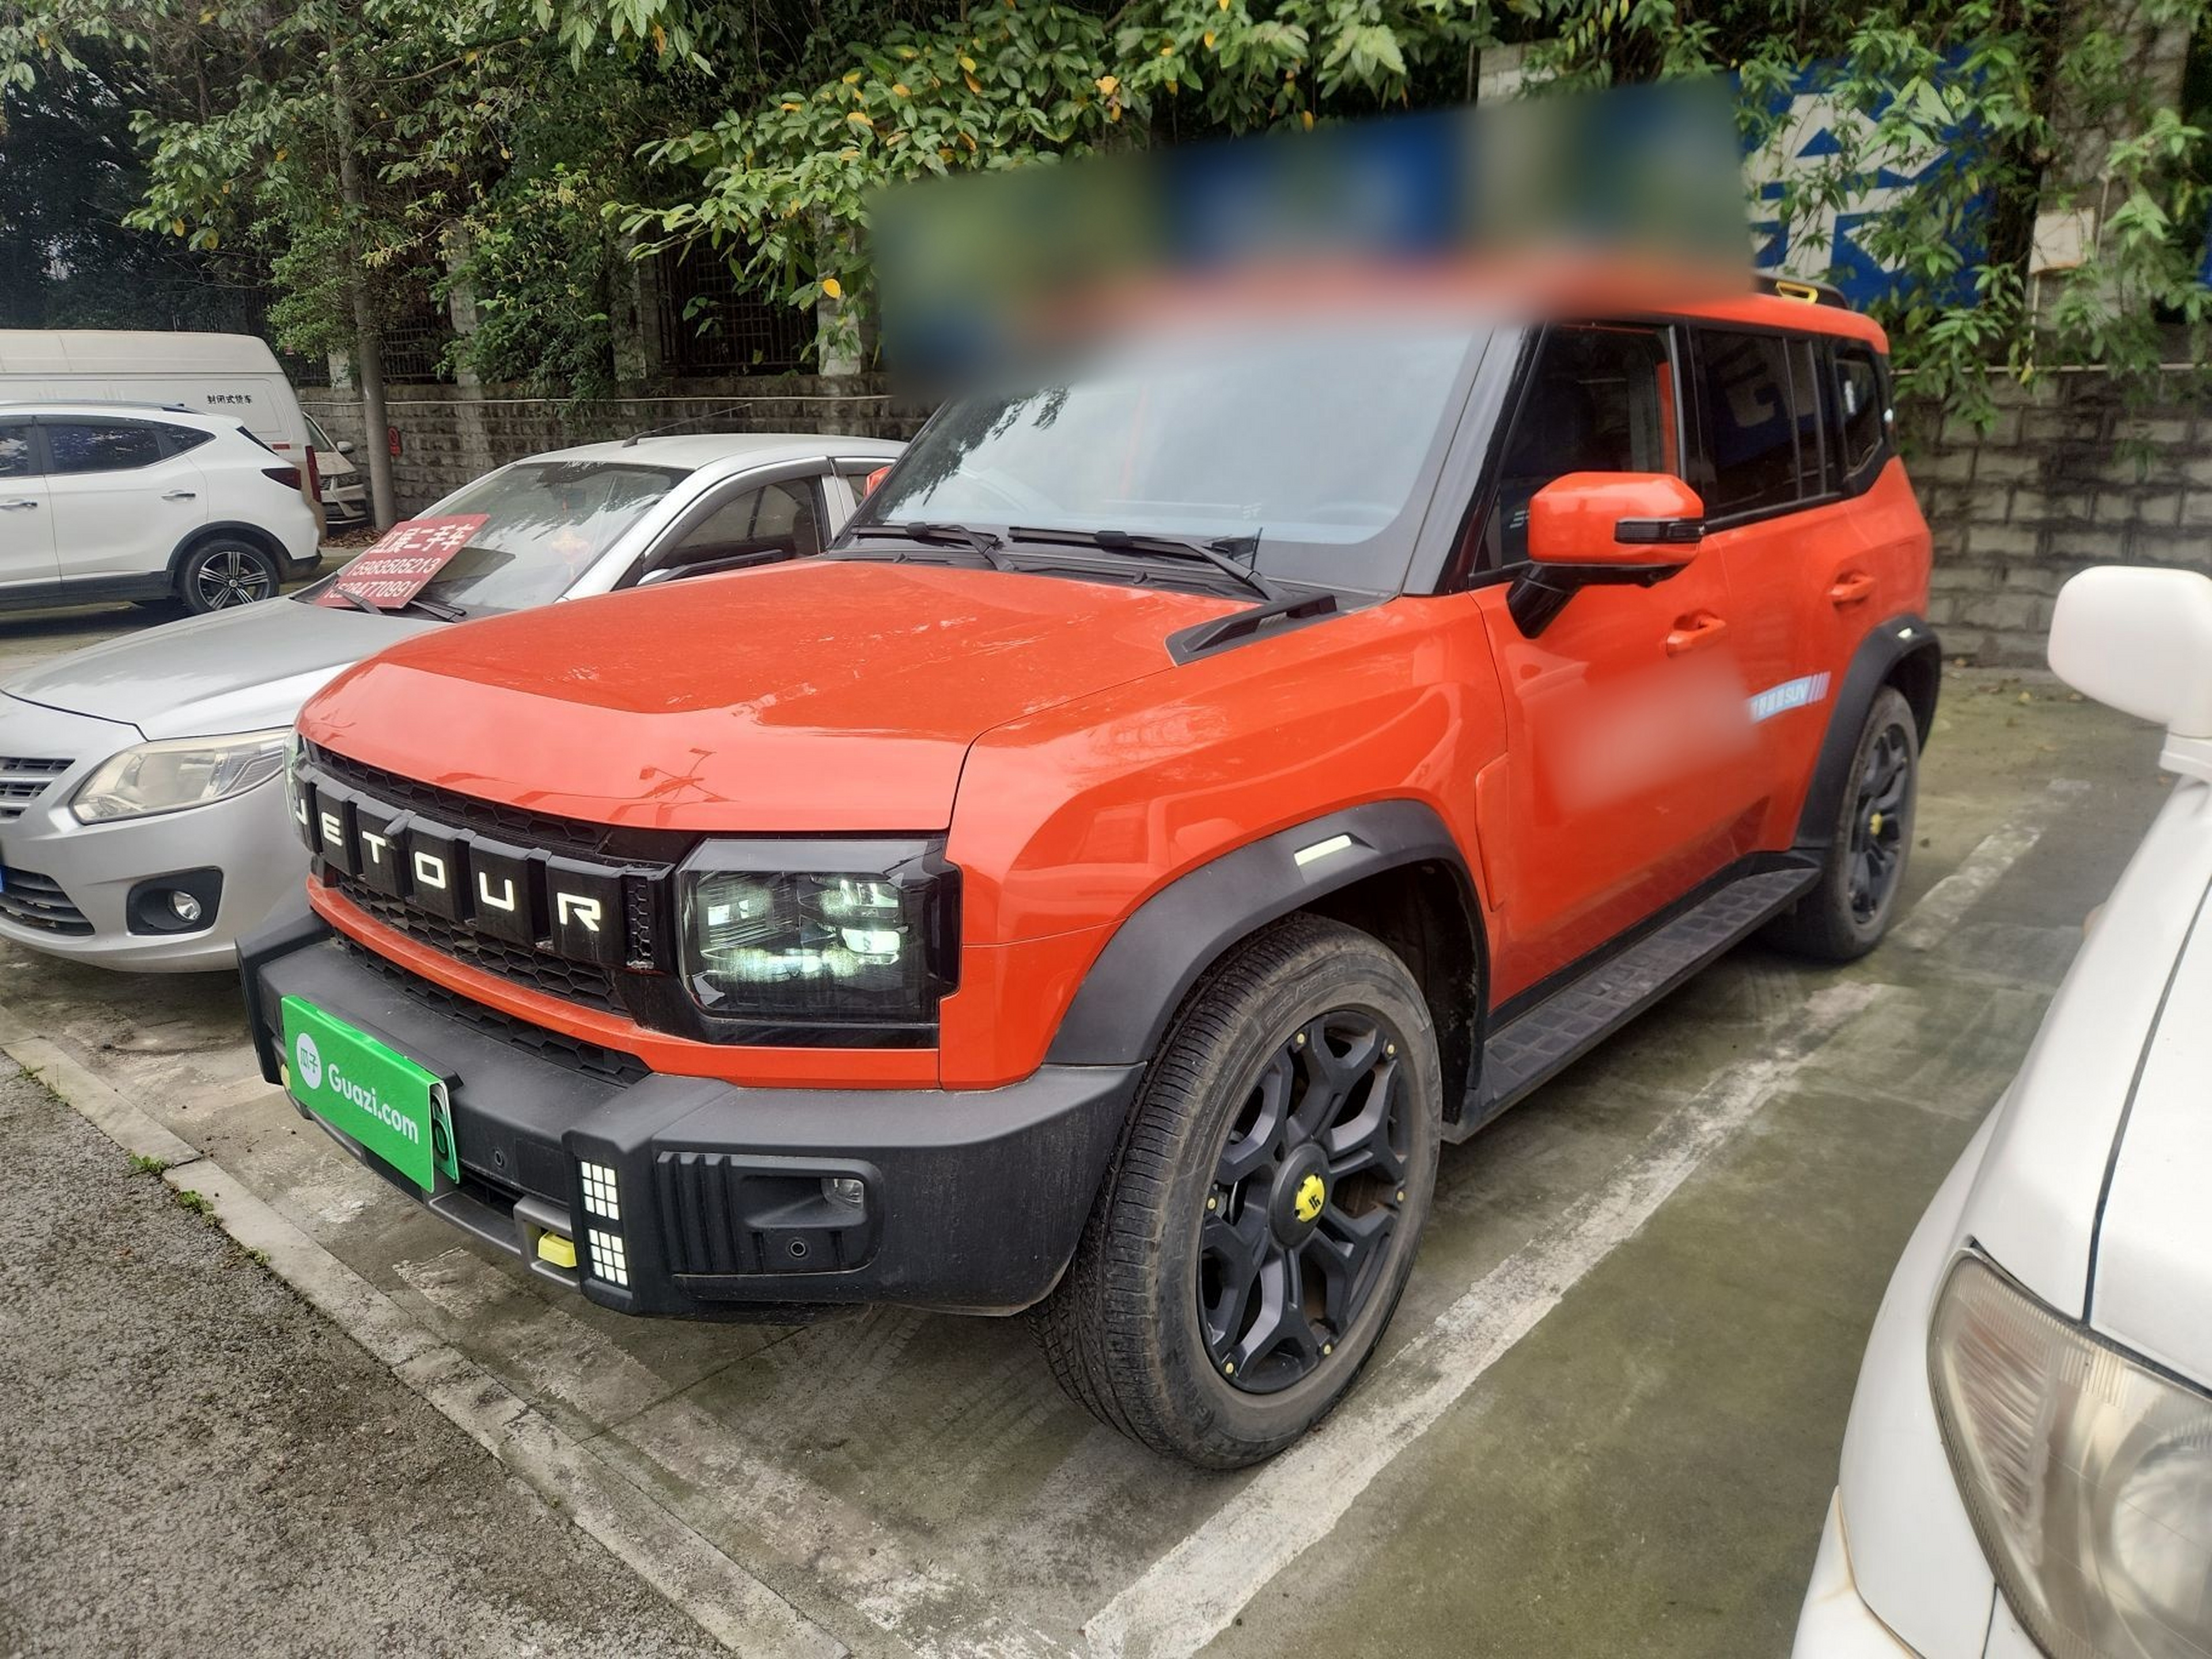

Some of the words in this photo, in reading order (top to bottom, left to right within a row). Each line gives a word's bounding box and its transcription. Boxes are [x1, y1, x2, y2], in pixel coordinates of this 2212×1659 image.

[207, 395, 252, 404] 封闭式货车
[294, 799, 601, 932] JETOUR
[301, 1047, 318, 1073] 瓜子
[328, 1063, 419, 1145] Guazi.com
